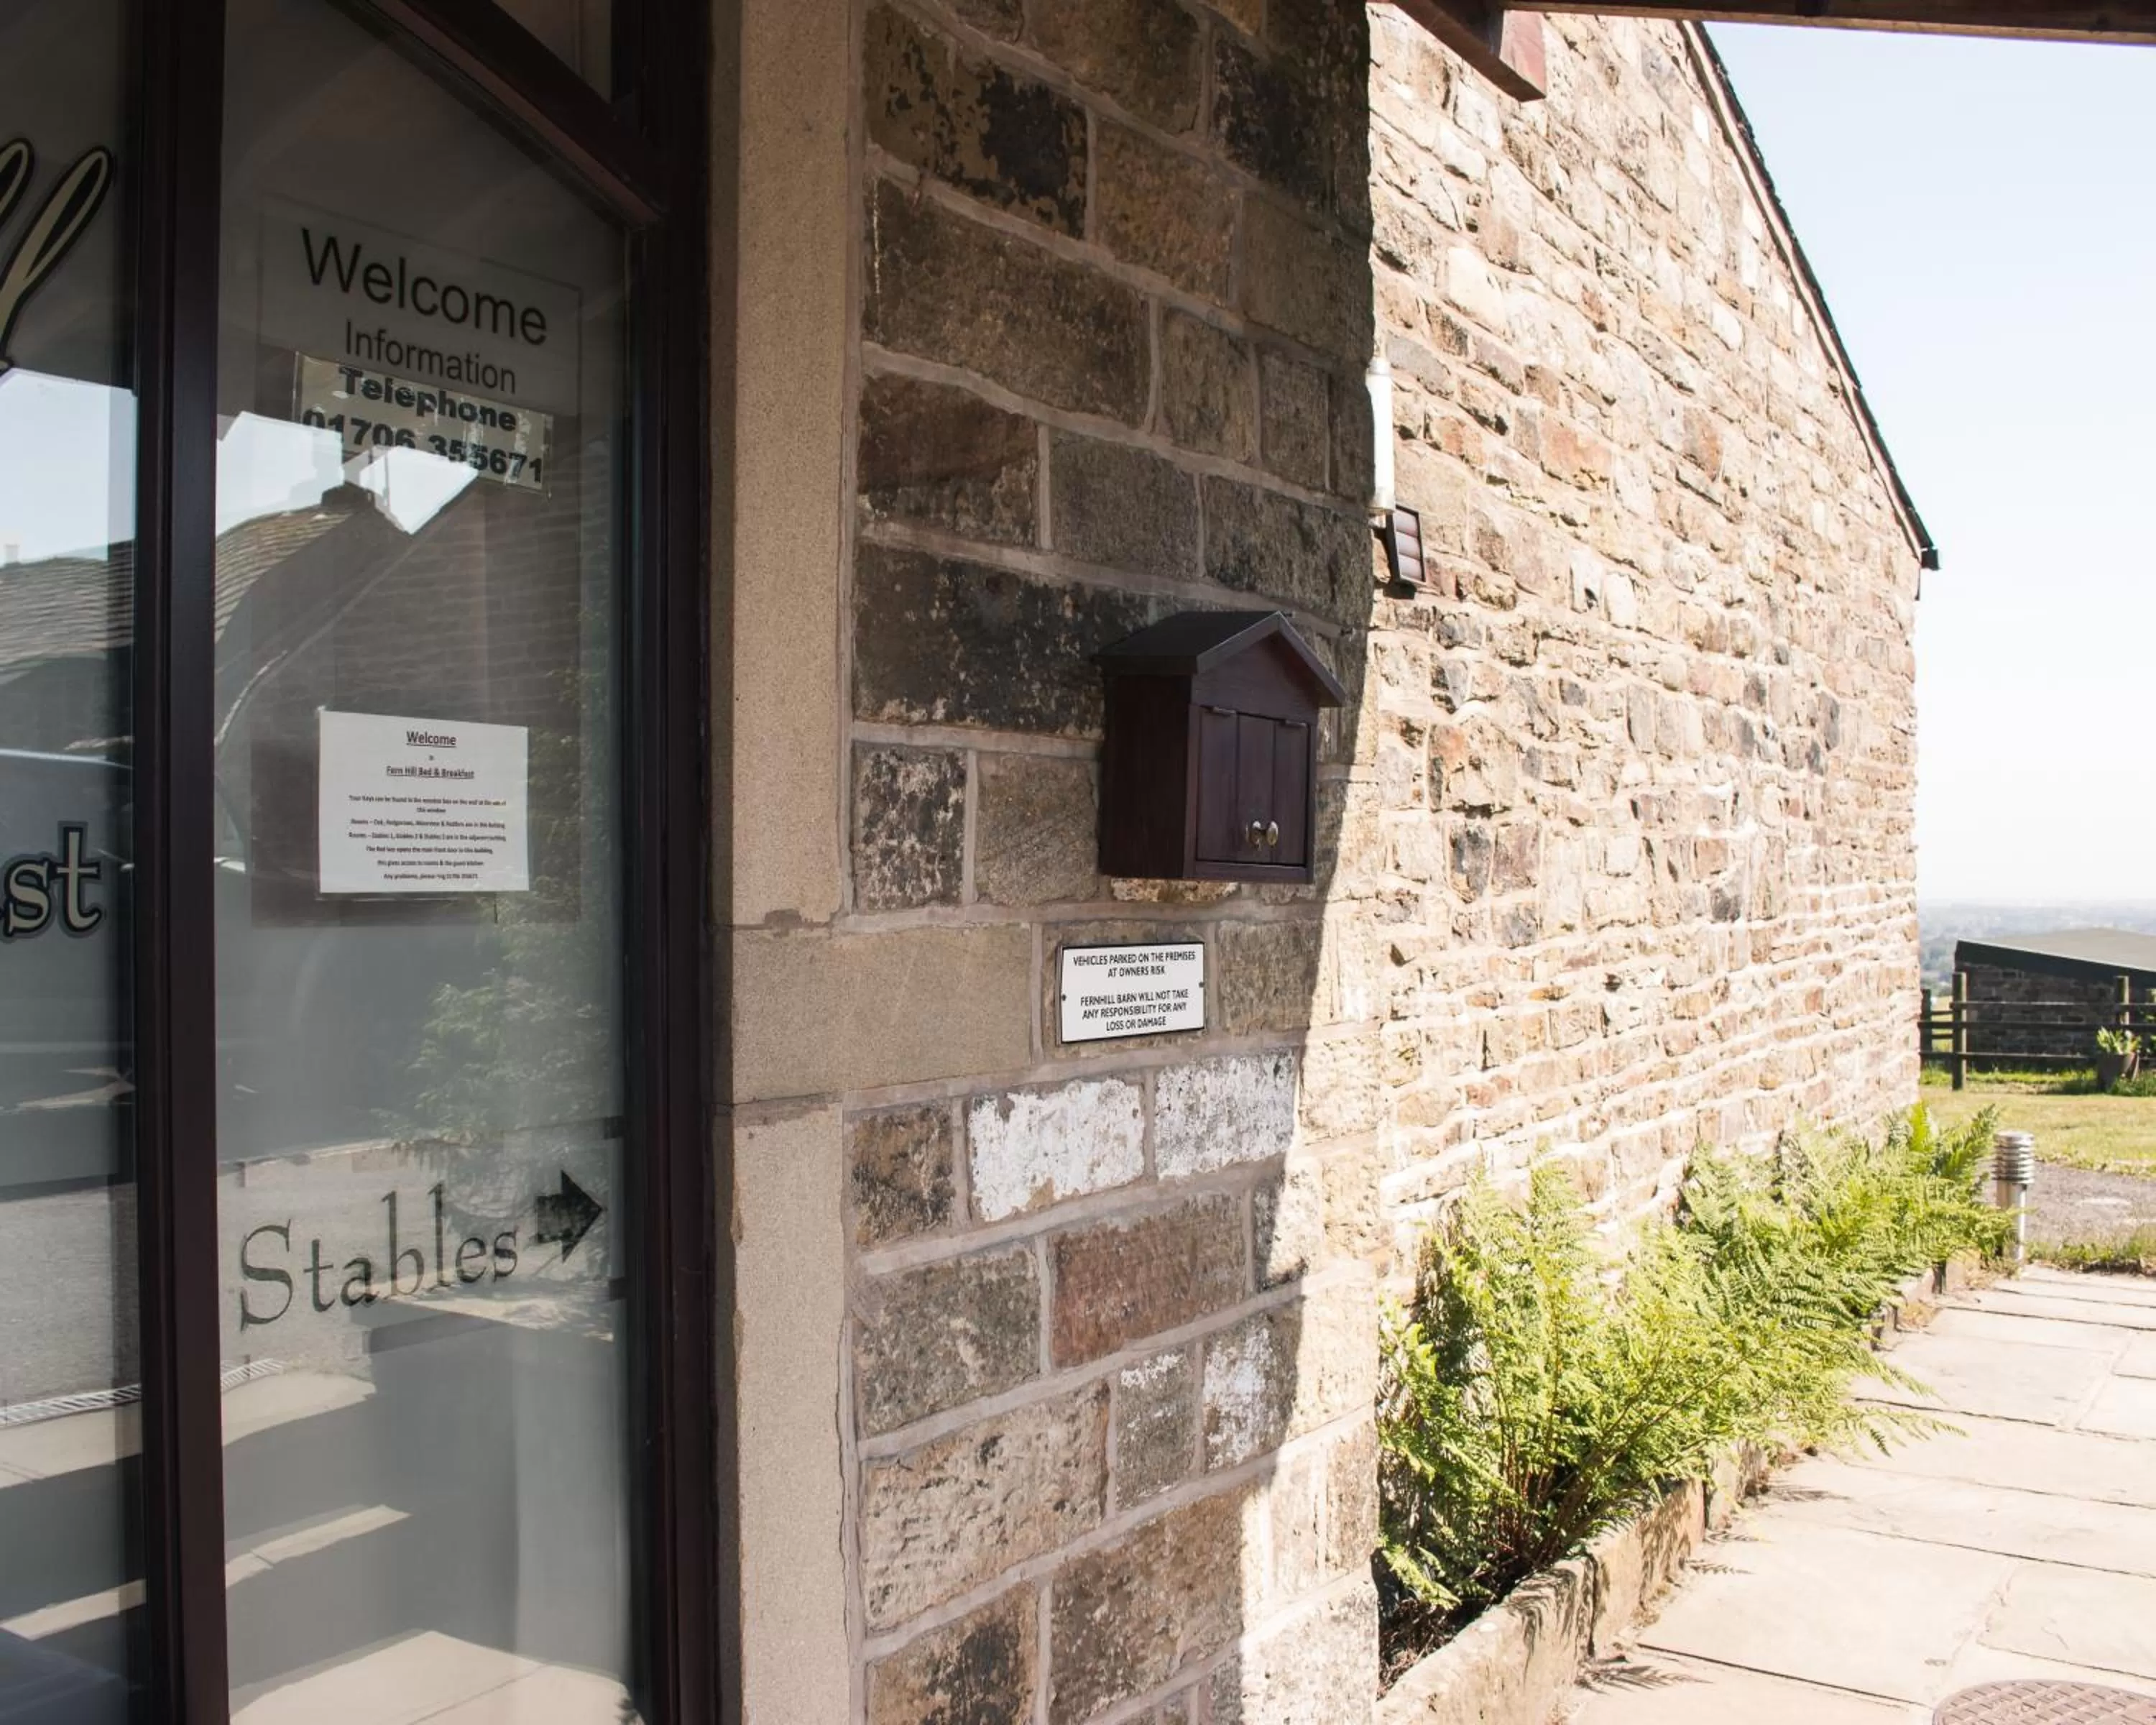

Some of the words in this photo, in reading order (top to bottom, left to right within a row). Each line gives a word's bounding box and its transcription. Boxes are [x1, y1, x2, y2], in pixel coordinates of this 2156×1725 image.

[302, 228, 548, 346] Welcome
[346, 319, 517, 395] Information
[339, 365, 517, 432] Telephone
[406, 730, 457, 745] Welcome
[1073, 954, 1107, 966] VEHICLES
[1109, 952, 1136, 965] PARKED
[1138, 952, 1149, 963] ON
[1151, 952, 1164, 962] THE
[1165, 951, 1195, 962] PREMISES
[1107, 968, 1116, 978] AT
[1119, 966, 1148, 977] OWNERS
[1151, 965, 1165, 975] RISK
[1080, 995, 1115, 1007] FERNHILL
[1117, 993, 1136, 1004] BARN
[1138, 991, 1153, 1002] WILL
[1155, 990, 1170, 1001] NOT
[1172, 988, 1189, 999] TAKE
[1082, 1009, 1099, 1020] ANY
[1100, 1005, 1156, 1018] RESPONSIBILITY
[1158, 1003, 1171, 1013] FOR
[1173, 1002, 1187, 1012] ANY
[1106, 1019, 1124, 1031] LOSS
[1125, 1019, 1135, 1030] OR
[1138, 1016, 1166, 1029] DAMAGE
[240, 1182, 518, 1332] Stables
